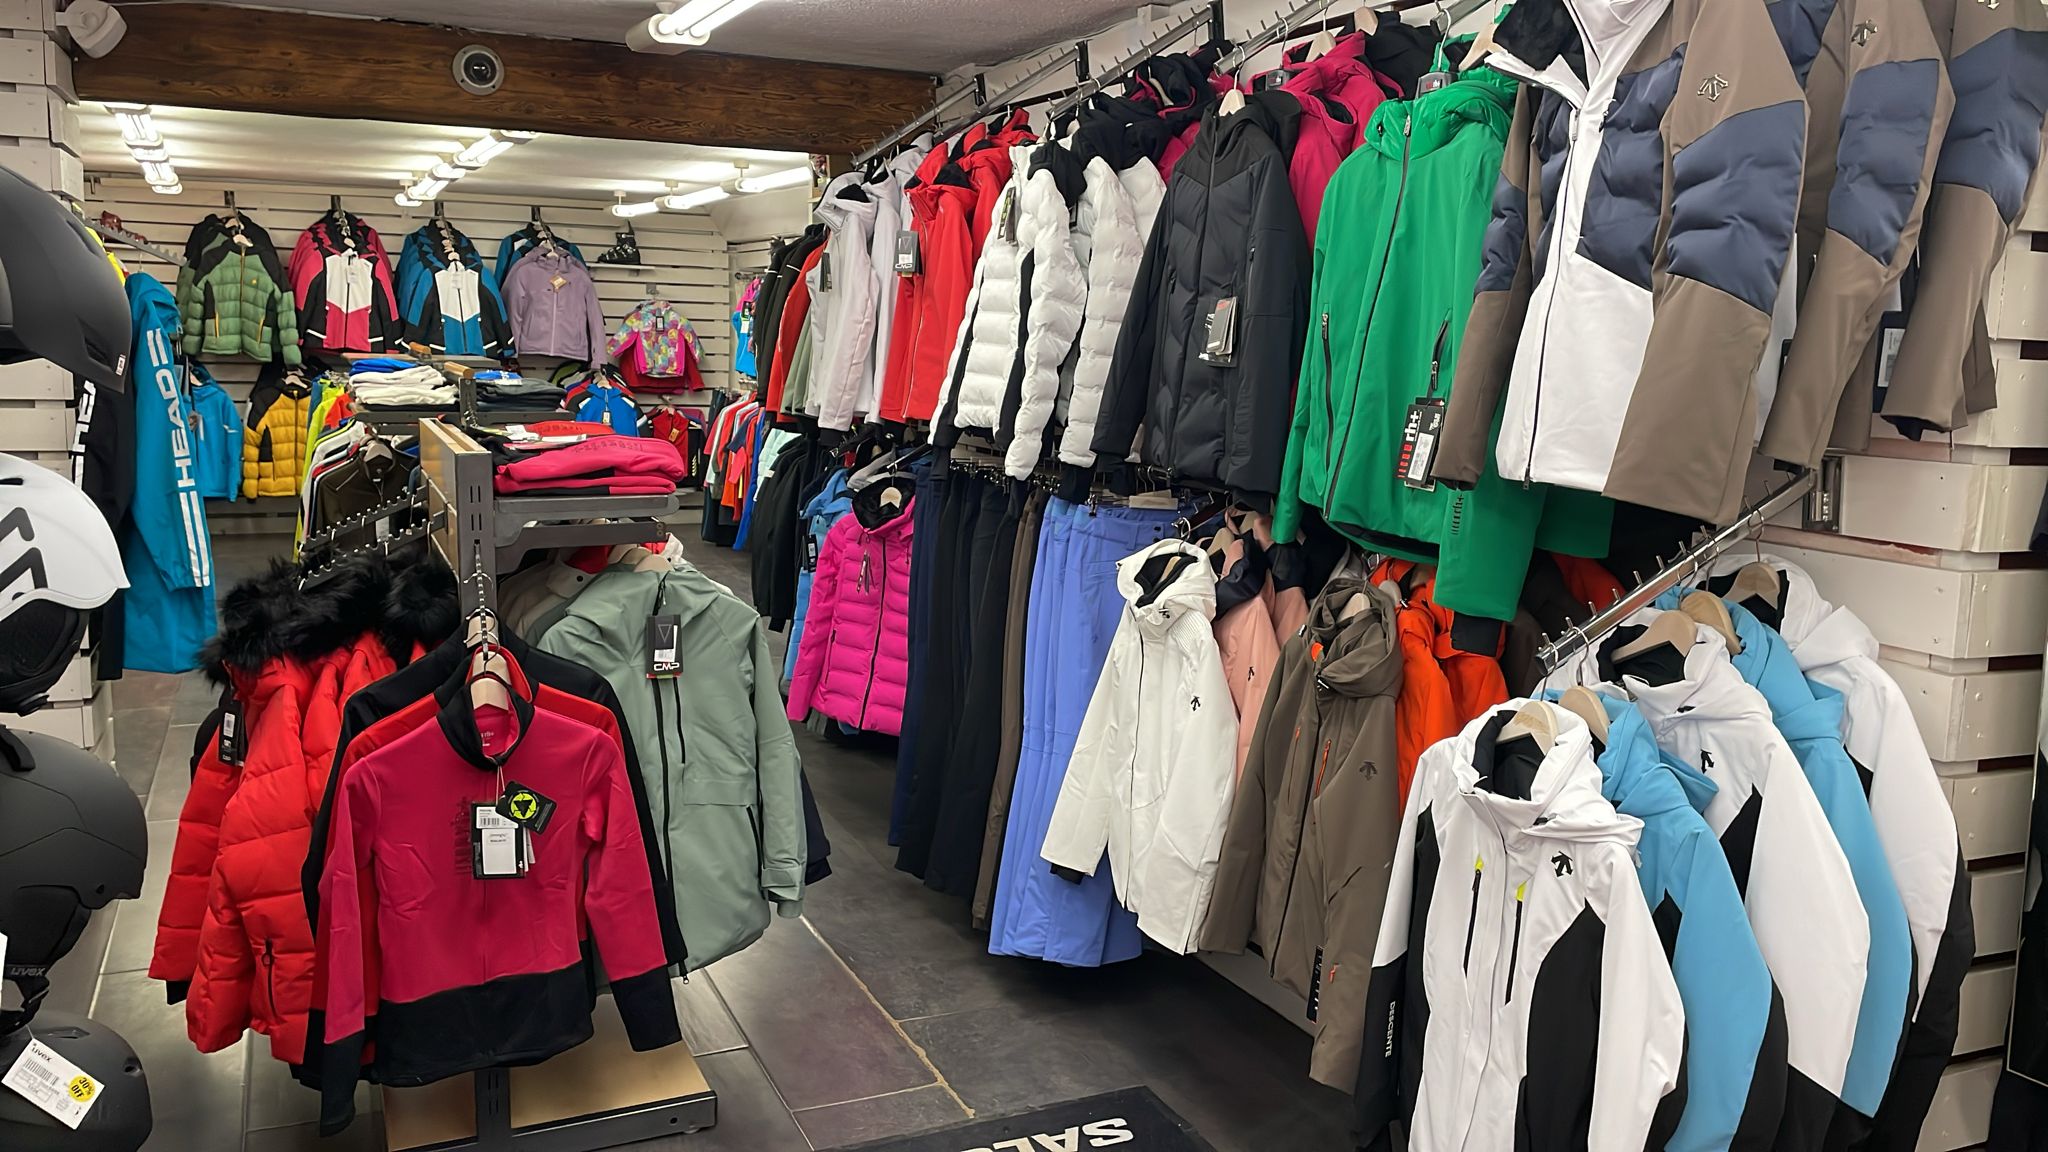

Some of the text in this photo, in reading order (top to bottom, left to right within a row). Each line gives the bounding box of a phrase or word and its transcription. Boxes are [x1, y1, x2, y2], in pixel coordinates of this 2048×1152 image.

[156, 367, 196, 489] HEAD
[1404, 410, 1420, 442] rh+
[653, 662, 680, 671] CMP
[11, 967, 46, 977] uvex
[1385, 1000, 1396, 1058] DESCENTE
[31, 1046, 53, 1063] uvex
[71, 1084, 84, 1098] OFF
